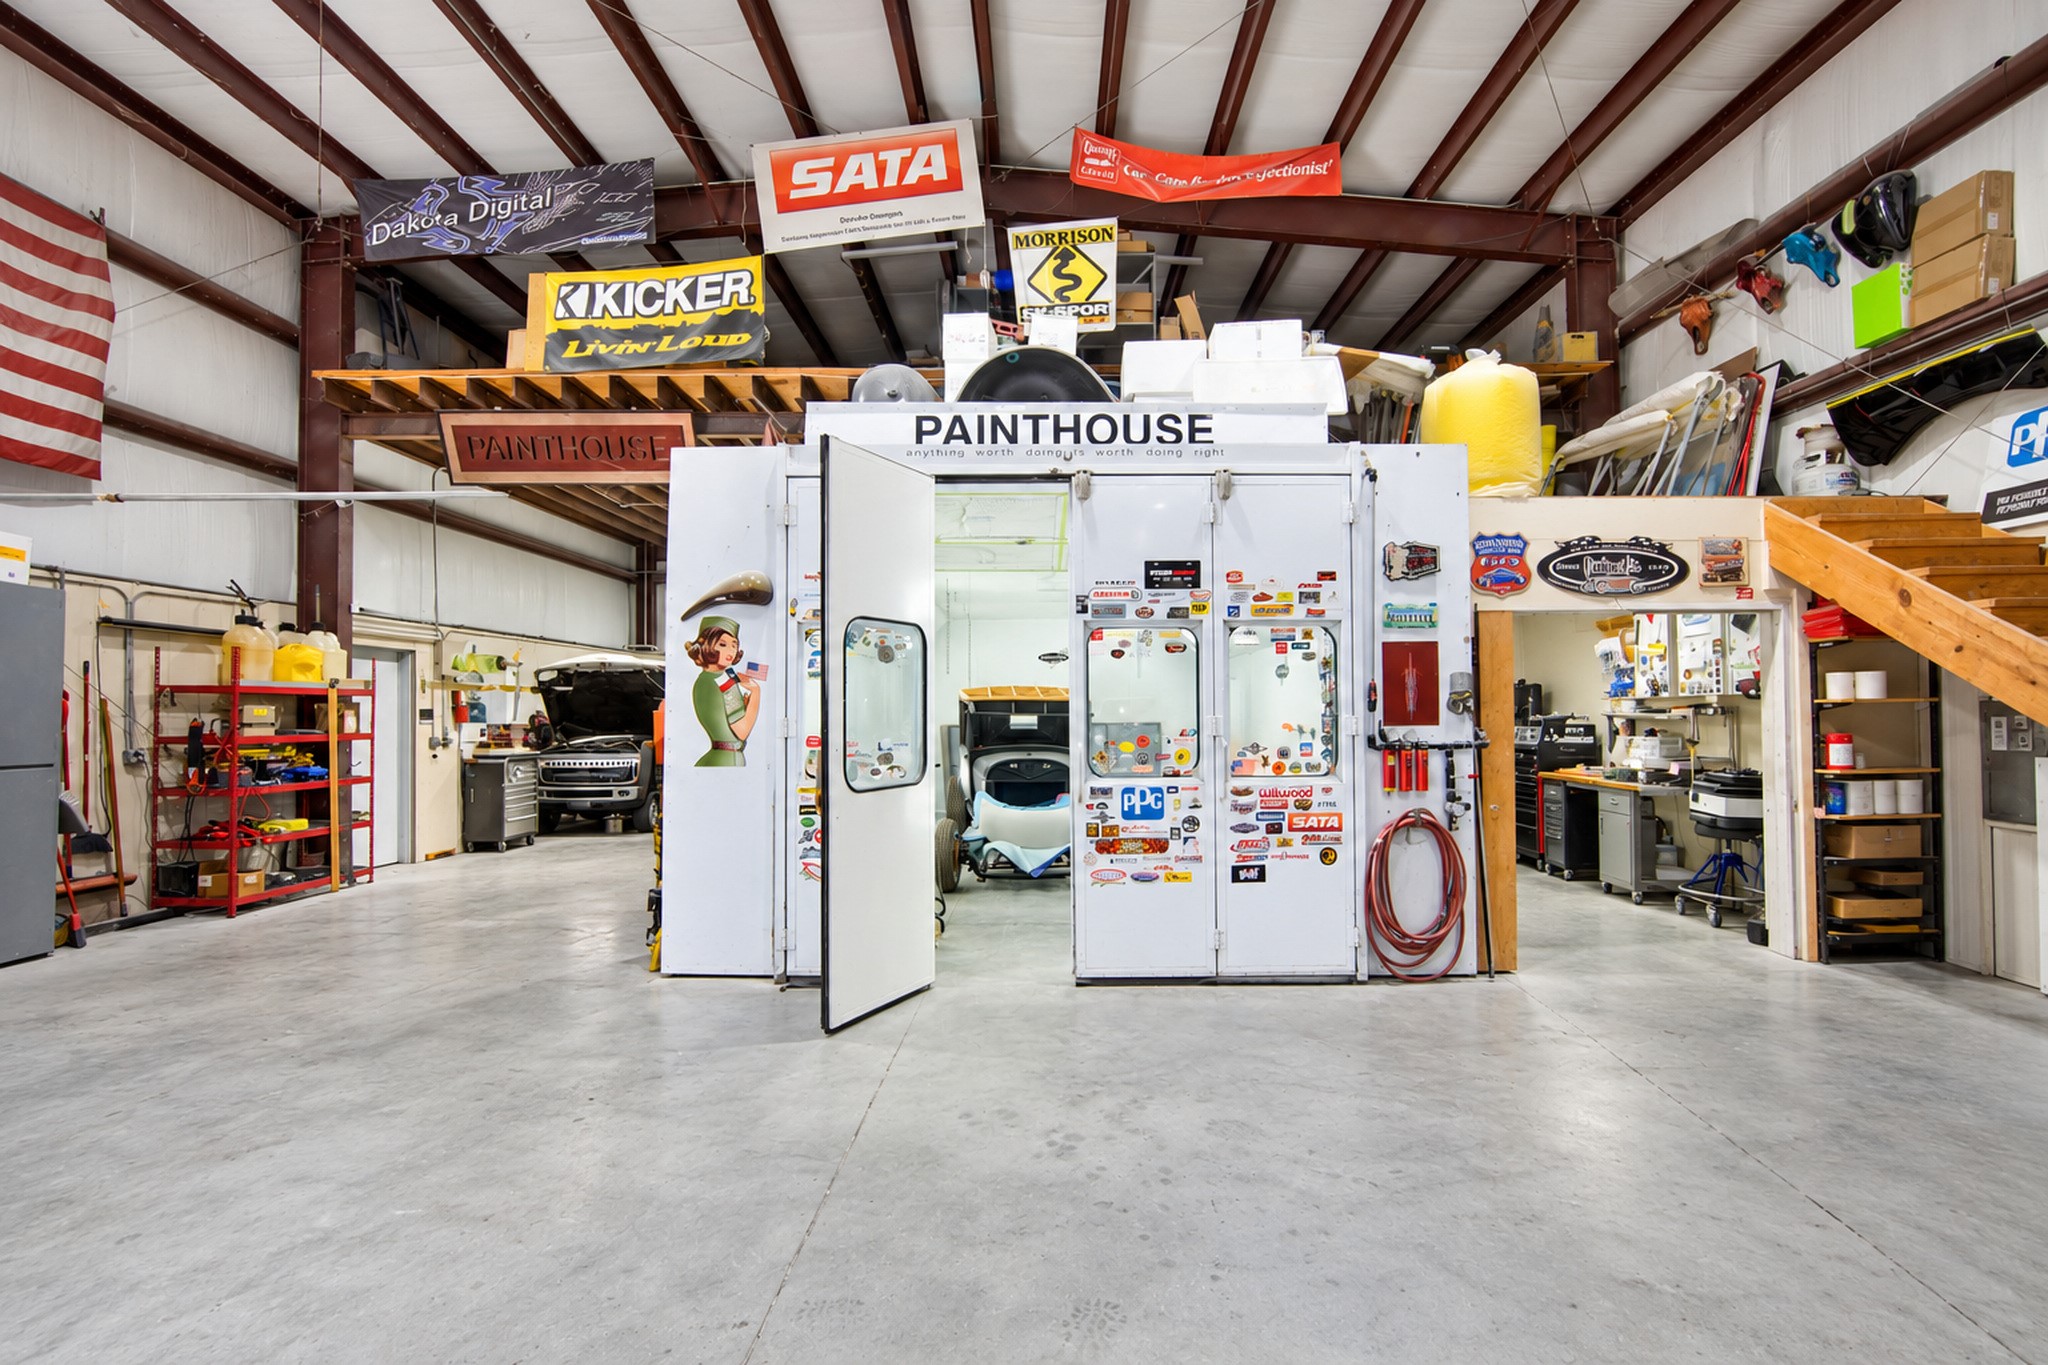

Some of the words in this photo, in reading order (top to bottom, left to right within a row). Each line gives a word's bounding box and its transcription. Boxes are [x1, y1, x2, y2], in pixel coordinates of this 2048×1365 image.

[789, 143, 948, 200] SATA
[1123, 164, 1147, 179] Car
[469, 187, 552, 222] Digital
[1014, 226, 1114, 248] MORRISON
[592, 270, 751, 318] KICKER
[914, 413, 1215, 445] PAINTHOUSE
[466, 434, 670, 462] PAINTHOUSE
[906, 449, 966, 459] anything
[975, 449, 1014, 457] worth
[1026, 448, 1063, 458] doing
[1095, 449, 1134, 457] worth
[1146, 448, 1184, 458] doing
[1194, 448, 1225, 458] right
[1124, 786, 1163, 815] PPG
[1292, 816, 1340, 829] SATA
